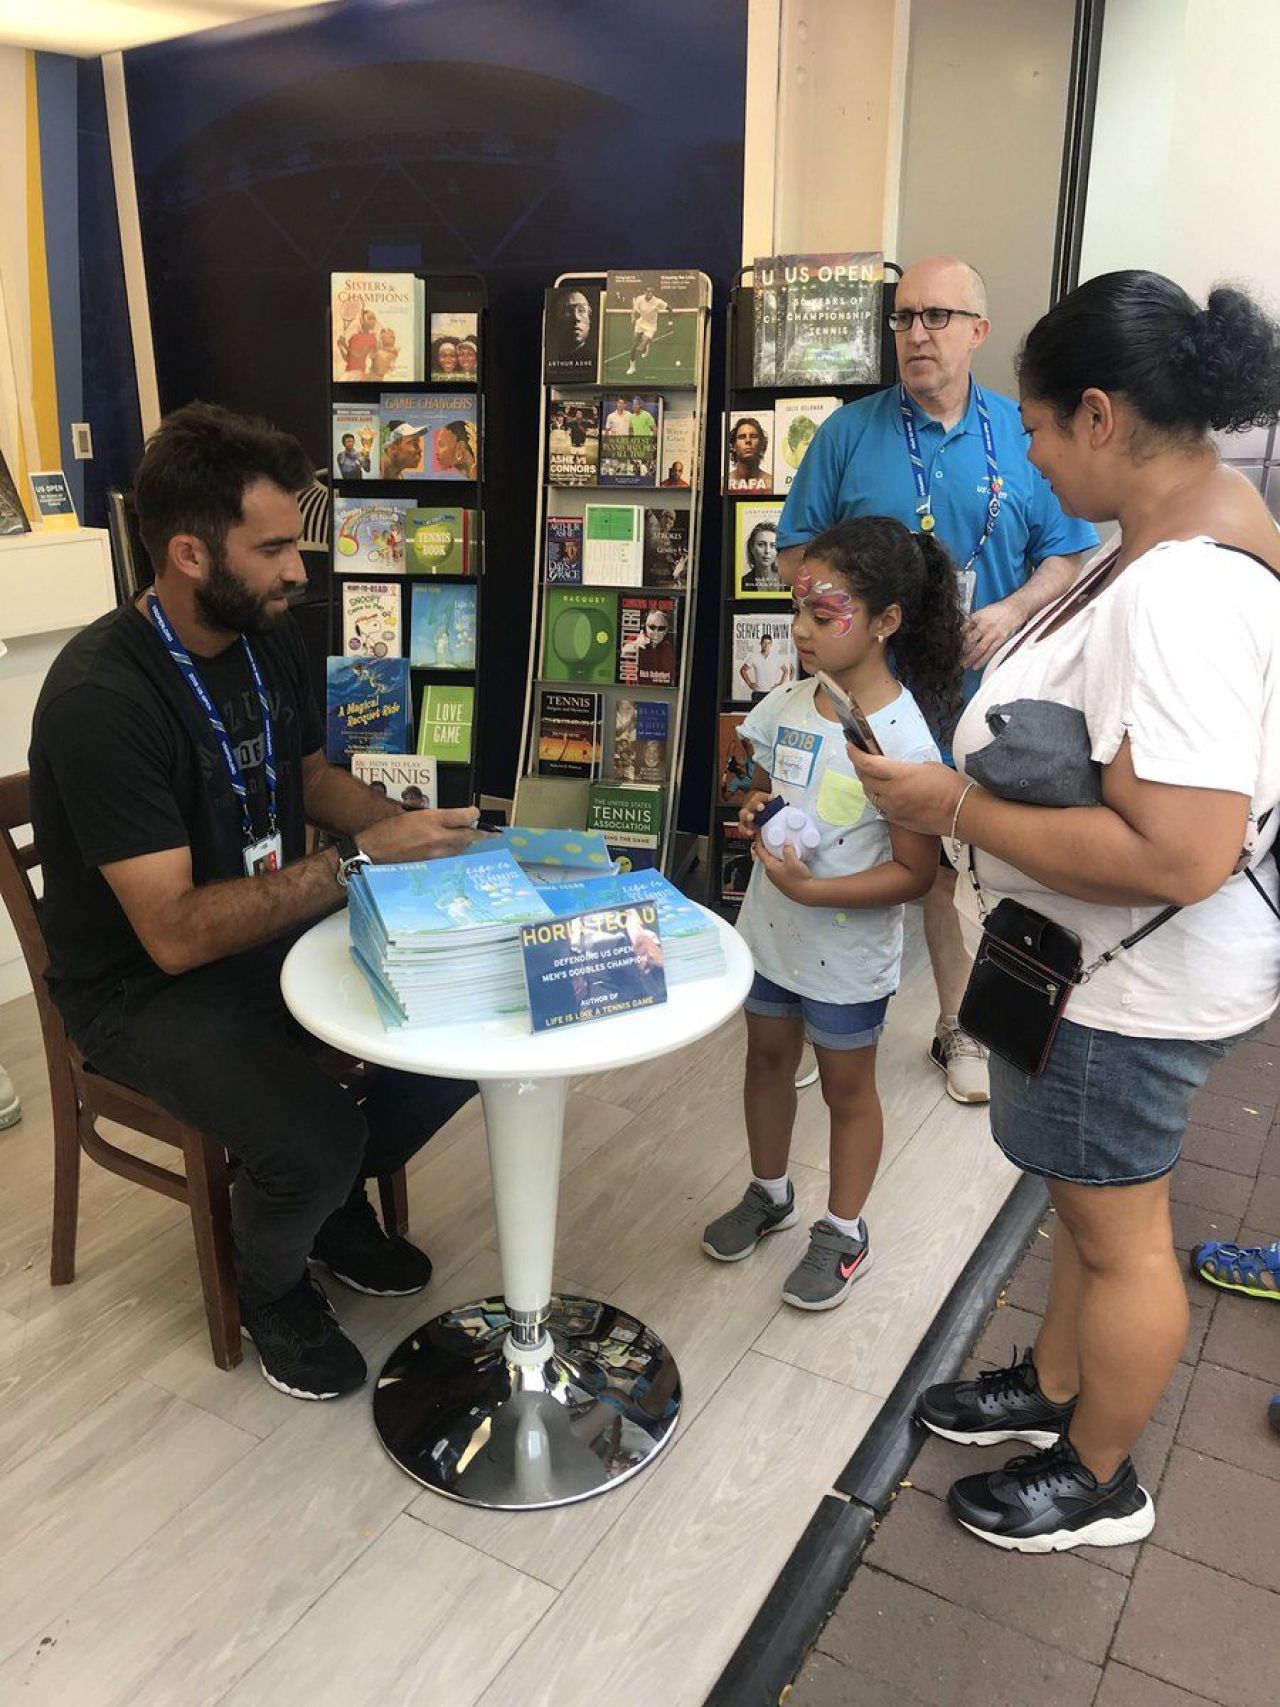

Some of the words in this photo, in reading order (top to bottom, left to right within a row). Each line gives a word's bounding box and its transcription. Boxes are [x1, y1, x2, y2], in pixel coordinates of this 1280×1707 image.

[785, 267, 809, 283] US
[818, 264, 873, 282] OPEN
[345, 280, 387, 291] SISTERS
[338, 291, 409, 305] CHAMPIONS
[850, 297, 863, 305] OF
[787, 311, 871, 321] CHAMPIONSHIP
[810, 327, 849, 335] TENNIS
[385, 397, 416, 410] GAME
[418, 397, 473, 411] CHANGERS
[550, 455, 575, 464] ASHE
[550, 464, 597, 473] CONNORS
[728, 478, 766, 489] RAFA
[418, 532, 451, 543] TENNIS
[423, 545, 446, 556] BOOK
[736, 622, 761, 639] SERVE
[773, 623, 789, 639] WIN
[547, 695, 591, 707] TENNIS
[436, 703, 463, 721] LOVE
[433, 726, 461, 744] GAME
[781, 730, 815, 750] 2018
[369, 760, 388, 768] HOW
[355, 767, 431, 785] TENNIS
[593, 806, 651, 823] TENNIS
[593, 820, 651, 831] ASSOCIATION
[523, 919, 585, 947] HORIA
[554, 951, 600, 968] DEFENDING
[602, 949, 612, 958] US
[613, 945, 635, 957] OPEN
[542, 970, 567, 982] MEN'S
[568, 965, 605, 977] DOUBLES
[606, 955, 649, 971] CHAMPION
[581, 994, 609, 1007] AUTHOR
[610, 992, 619, 1001] OF
[545, 1016, 563, 1027] LIFE
[565, 1013, 573, 1022] IS
[574, 1009, 593, 1021] LIKE
[595, 1008, 601, 1016] A
[602, 1001, 630, 1014] TENNIS
[632, 996, 654, 1008] GAME
